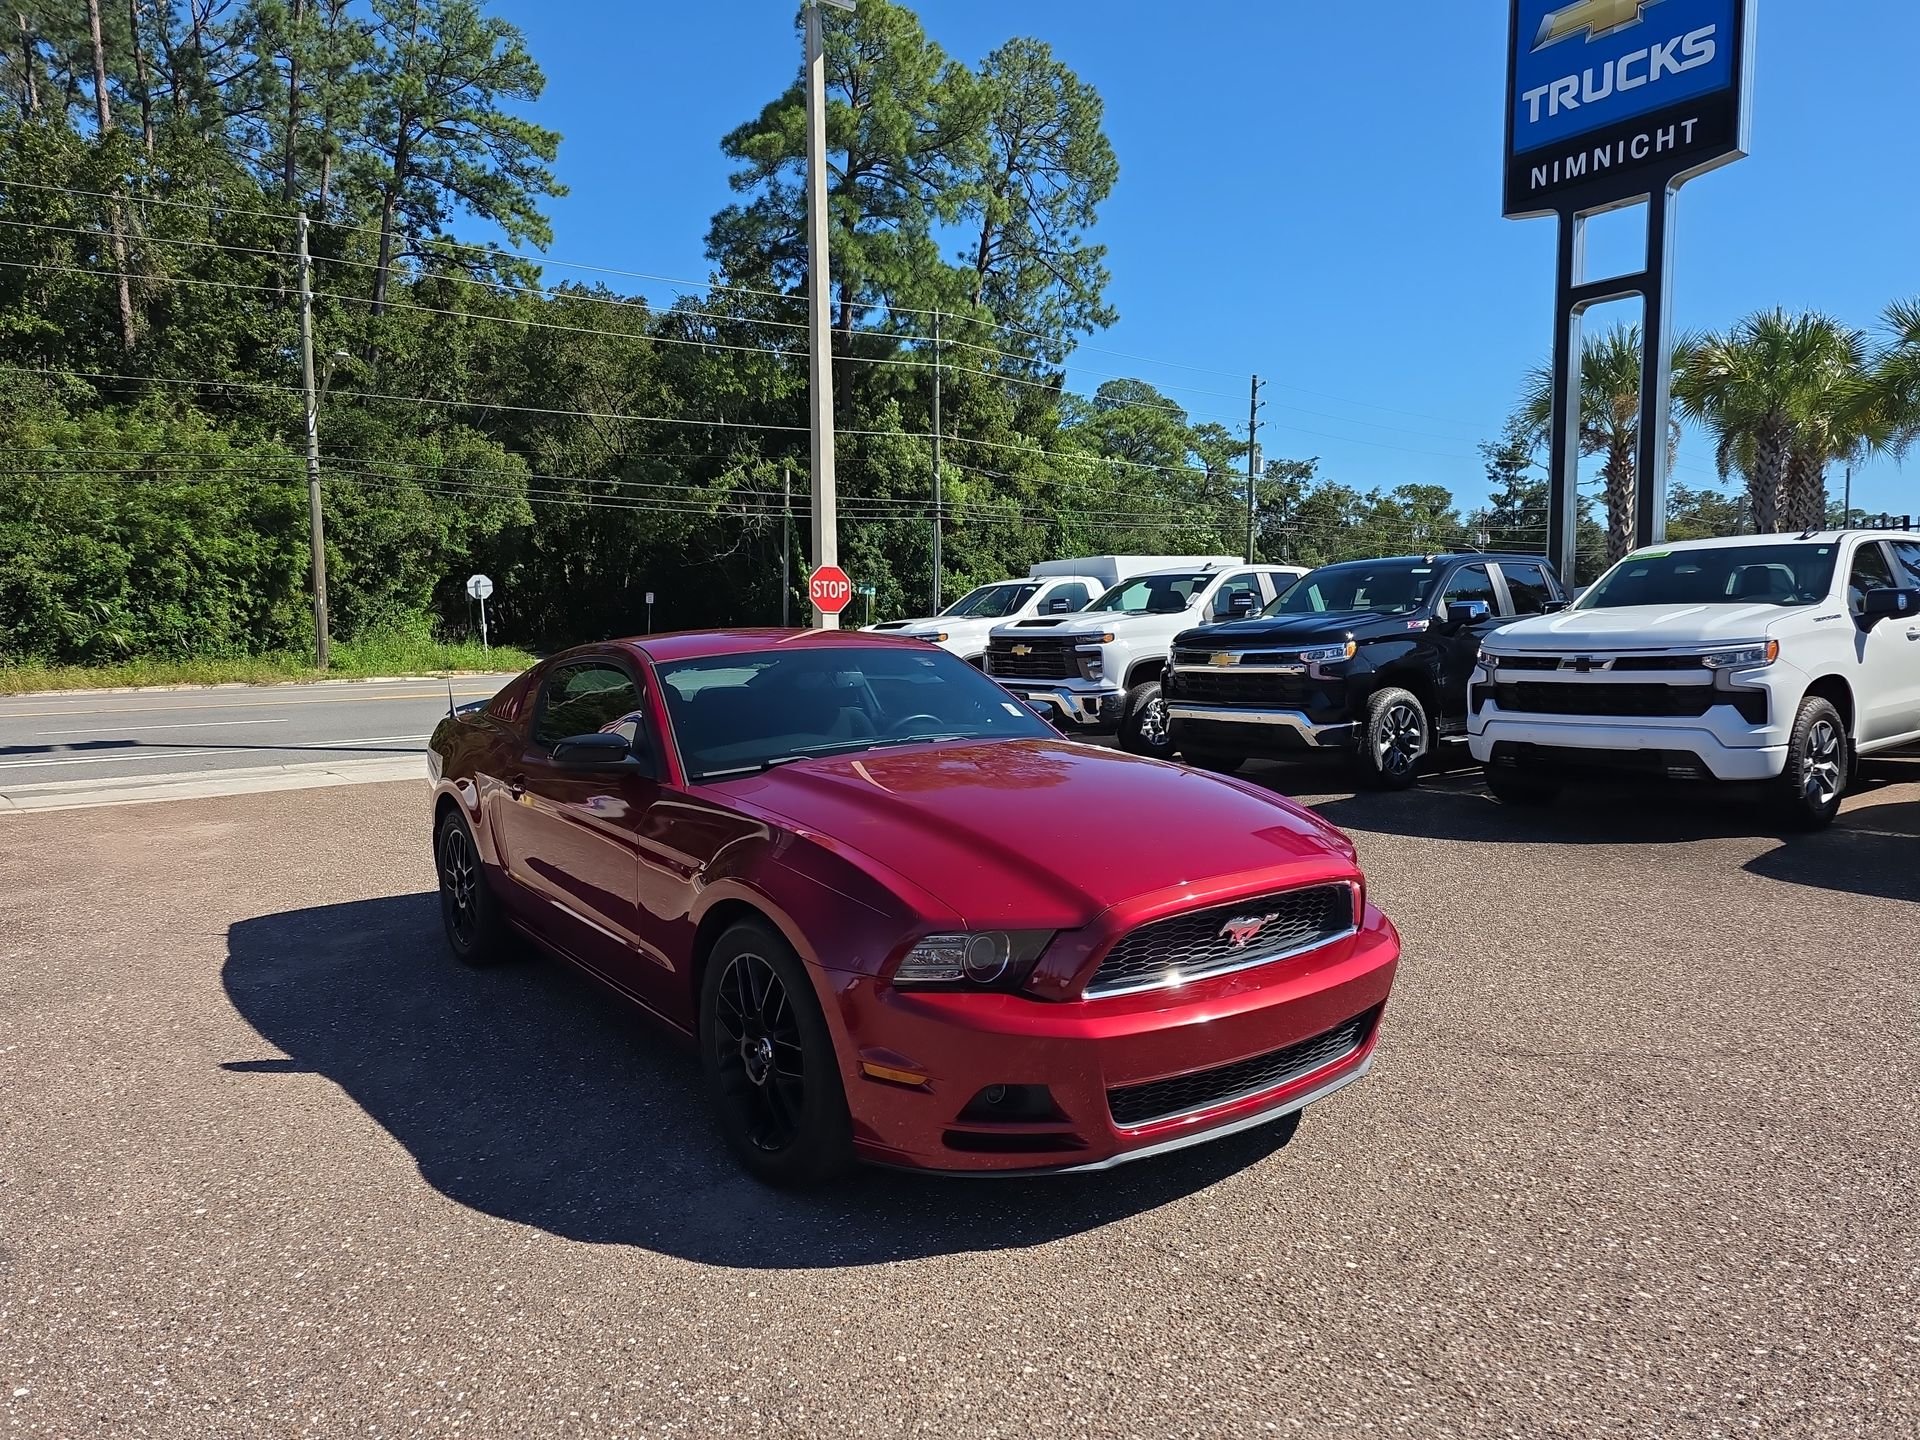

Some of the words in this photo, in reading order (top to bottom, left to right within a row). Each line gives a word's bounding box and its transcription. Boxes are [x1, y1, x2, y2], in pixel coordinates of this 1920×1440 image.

[1522, 24, 1716, 123] TRUCKS
[1531, 118, 1698, 189] NIMNICHT
[812, 581, 848, 598] STOP
